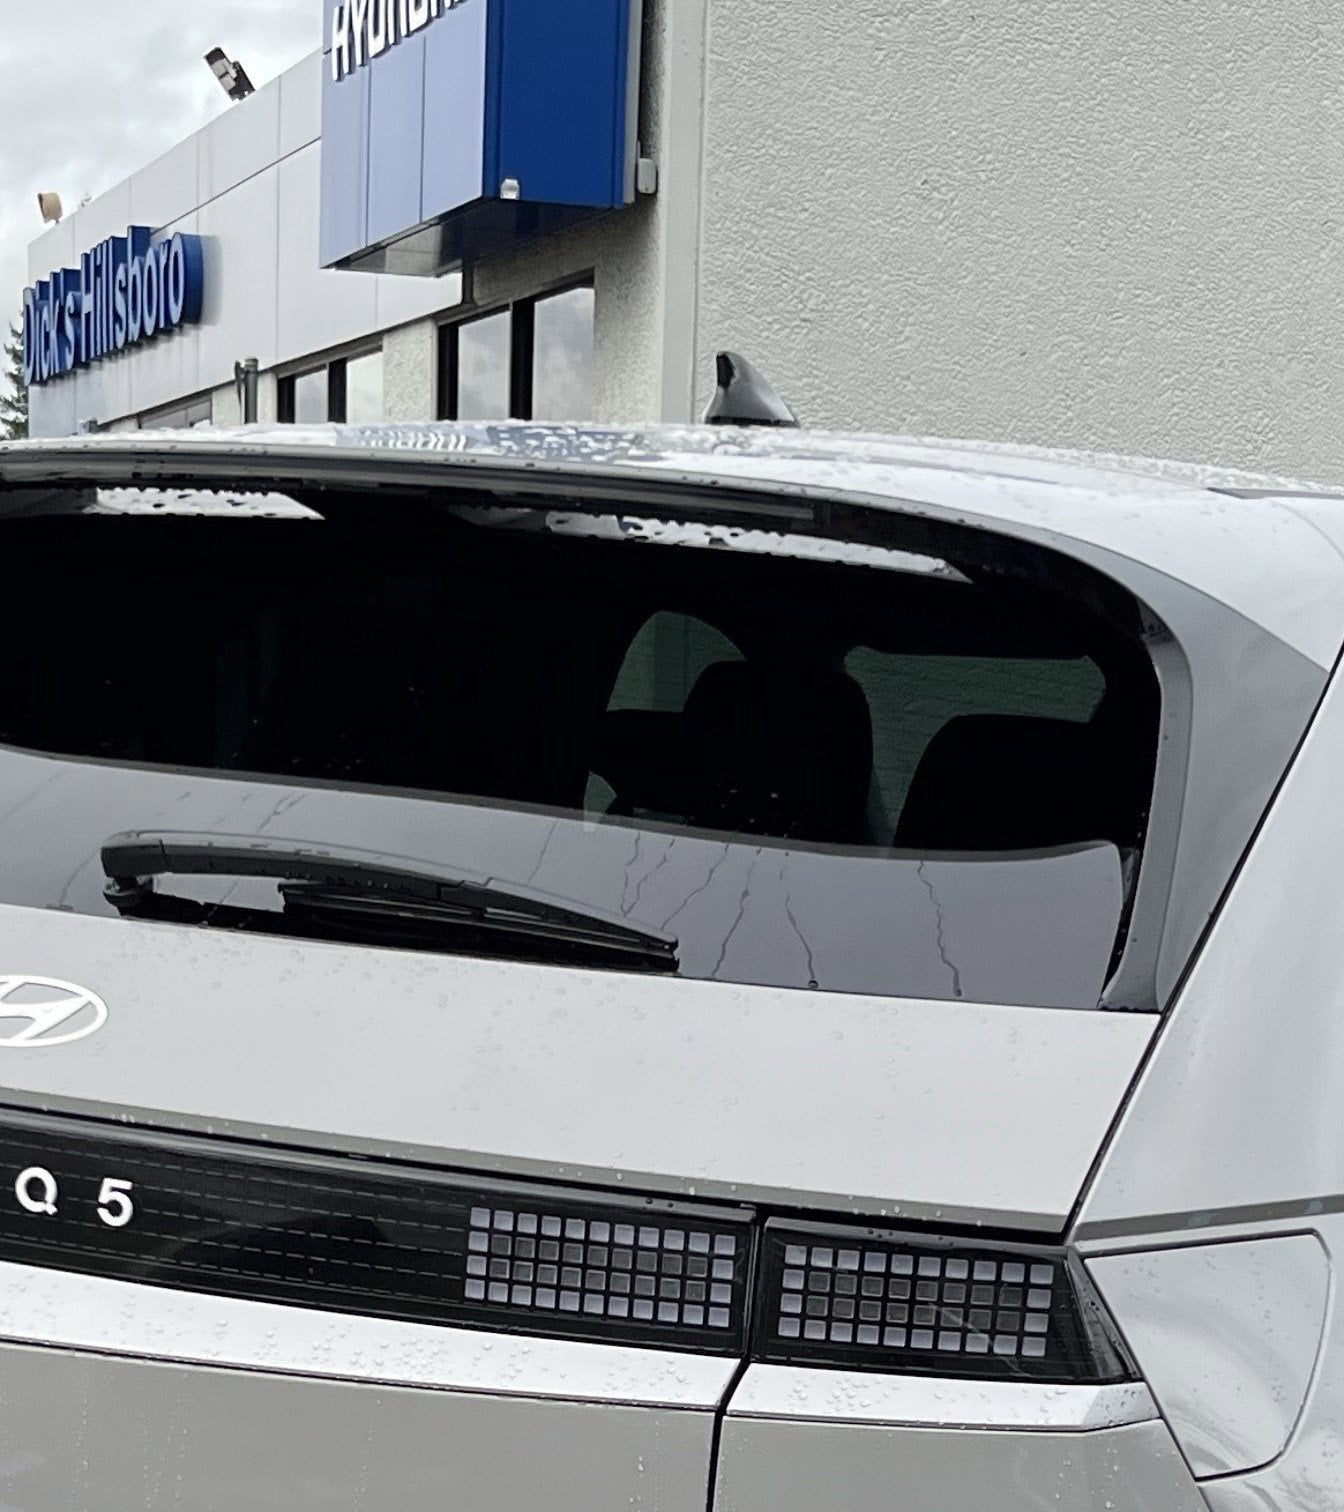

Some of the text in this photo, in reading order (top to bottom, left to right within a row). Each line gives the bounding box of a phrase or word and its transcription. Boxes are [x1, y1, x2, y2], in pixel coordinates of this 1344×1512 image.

[23, 226, 187, 387] Dick's Hillsboro
[97, 1177, 134, 1228] 5
